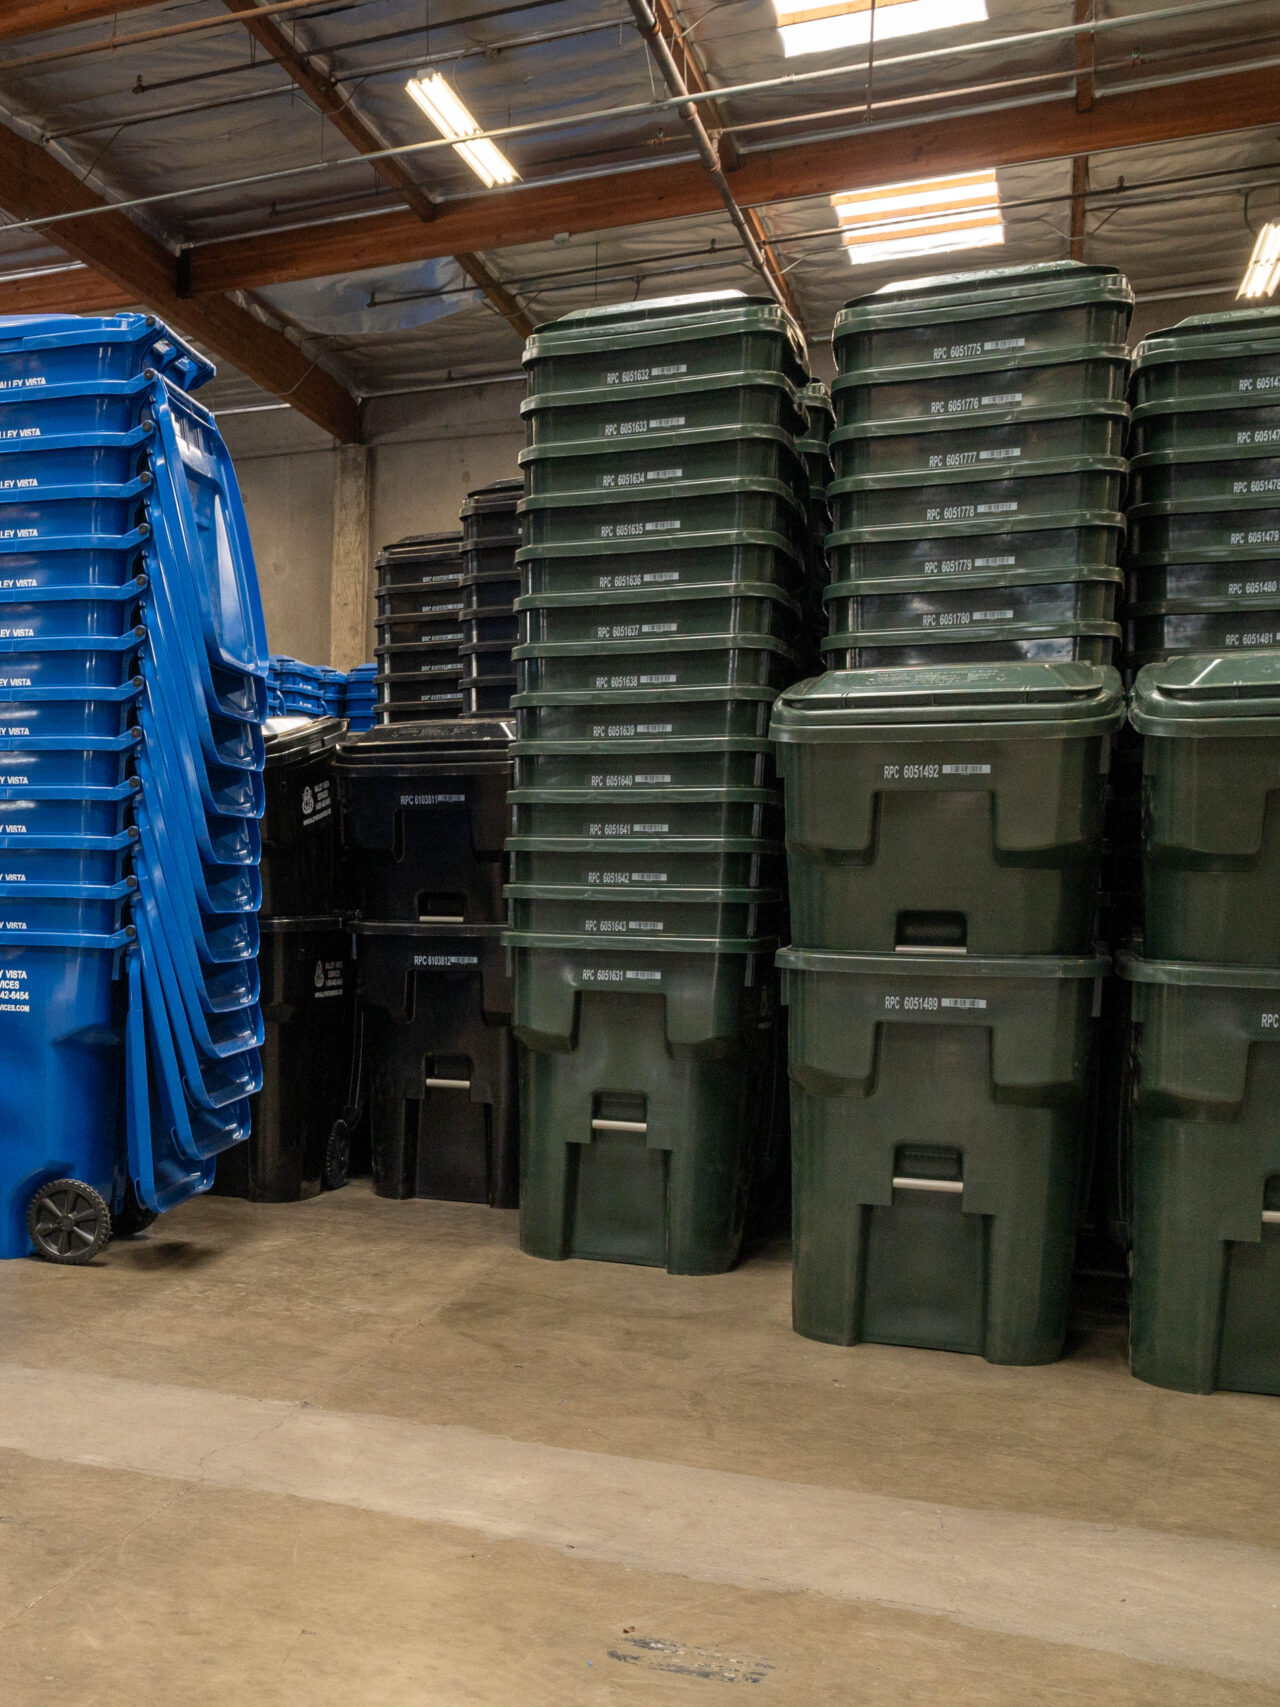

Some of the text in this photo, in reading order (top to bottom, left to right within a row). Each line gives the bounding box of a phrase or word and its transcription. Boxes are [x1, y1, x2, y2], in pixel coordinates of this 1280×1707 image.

[934, 343, 982, 360] RPC 6051775
[607, 368, 649, 384] RPC 6051632
[1239, 379, 1252, 390] RPC
[931, 398, 978, 414] RPC 6051776
[605, 421, 648, 436] RPC 6051633
[1237, 432, 1251, 444] RPC
[929, 452, 976, 468] RPC 6051777
[17, 478, 38, 488] VISTA
[602, 472, 644, 486] RPC 6051634
[1234, 482, 1247, 493] RPC
[927, 506, 974, 520] RPC 6051778
[17, 528, 38, 538] VISTA
[601, 523, 643, 537] RPC 6051635
[1230, 531, 1279, 544] RPC 6051479
[924, 559, 972, 574] RPC 6051779
[16, 578, 37, 588] VISTA
[600, 574, 642, 588] RPC 6051636
[1228, 581, 1276, 594] RPC 6051480
[922, 613, 970, 626] RPC 6051780
[12, 628, 34, 638] VISTA
[598, 625, 640, 638] RPC 6051637
[1226, 632, 1273, 646] RPC 6051481
[10, 678, 32, 686] VISTA
[596, 676, 638, 688] RPC 6051638
[8, 727, 30, 736] VISTA
[593, 724, 634, 736] RPC 6051639
[884, 764, 939, 778] RPC 6051492
[7, 776, 28, 784] VISTA
[591, 775, 632, 786] RPC 6051640
[400, 796, 414, 805] RPC
[6, 824, 27, 833] VISTA
[590, 824, 630, 835] RPC 6051641
[588, 872, 630, 884] RPC 6051642
[585, 920, 626, 932] RPC 6051643
[414, 956, 452, 966] RPC 6103812
[6, 970, 28, 979] VISTA
[582, 969, 624, 981] RPC 6051631
[885, 996, 938, 1010] RPC 6051489
[1262, 1014, 1279, 1028] RPC
